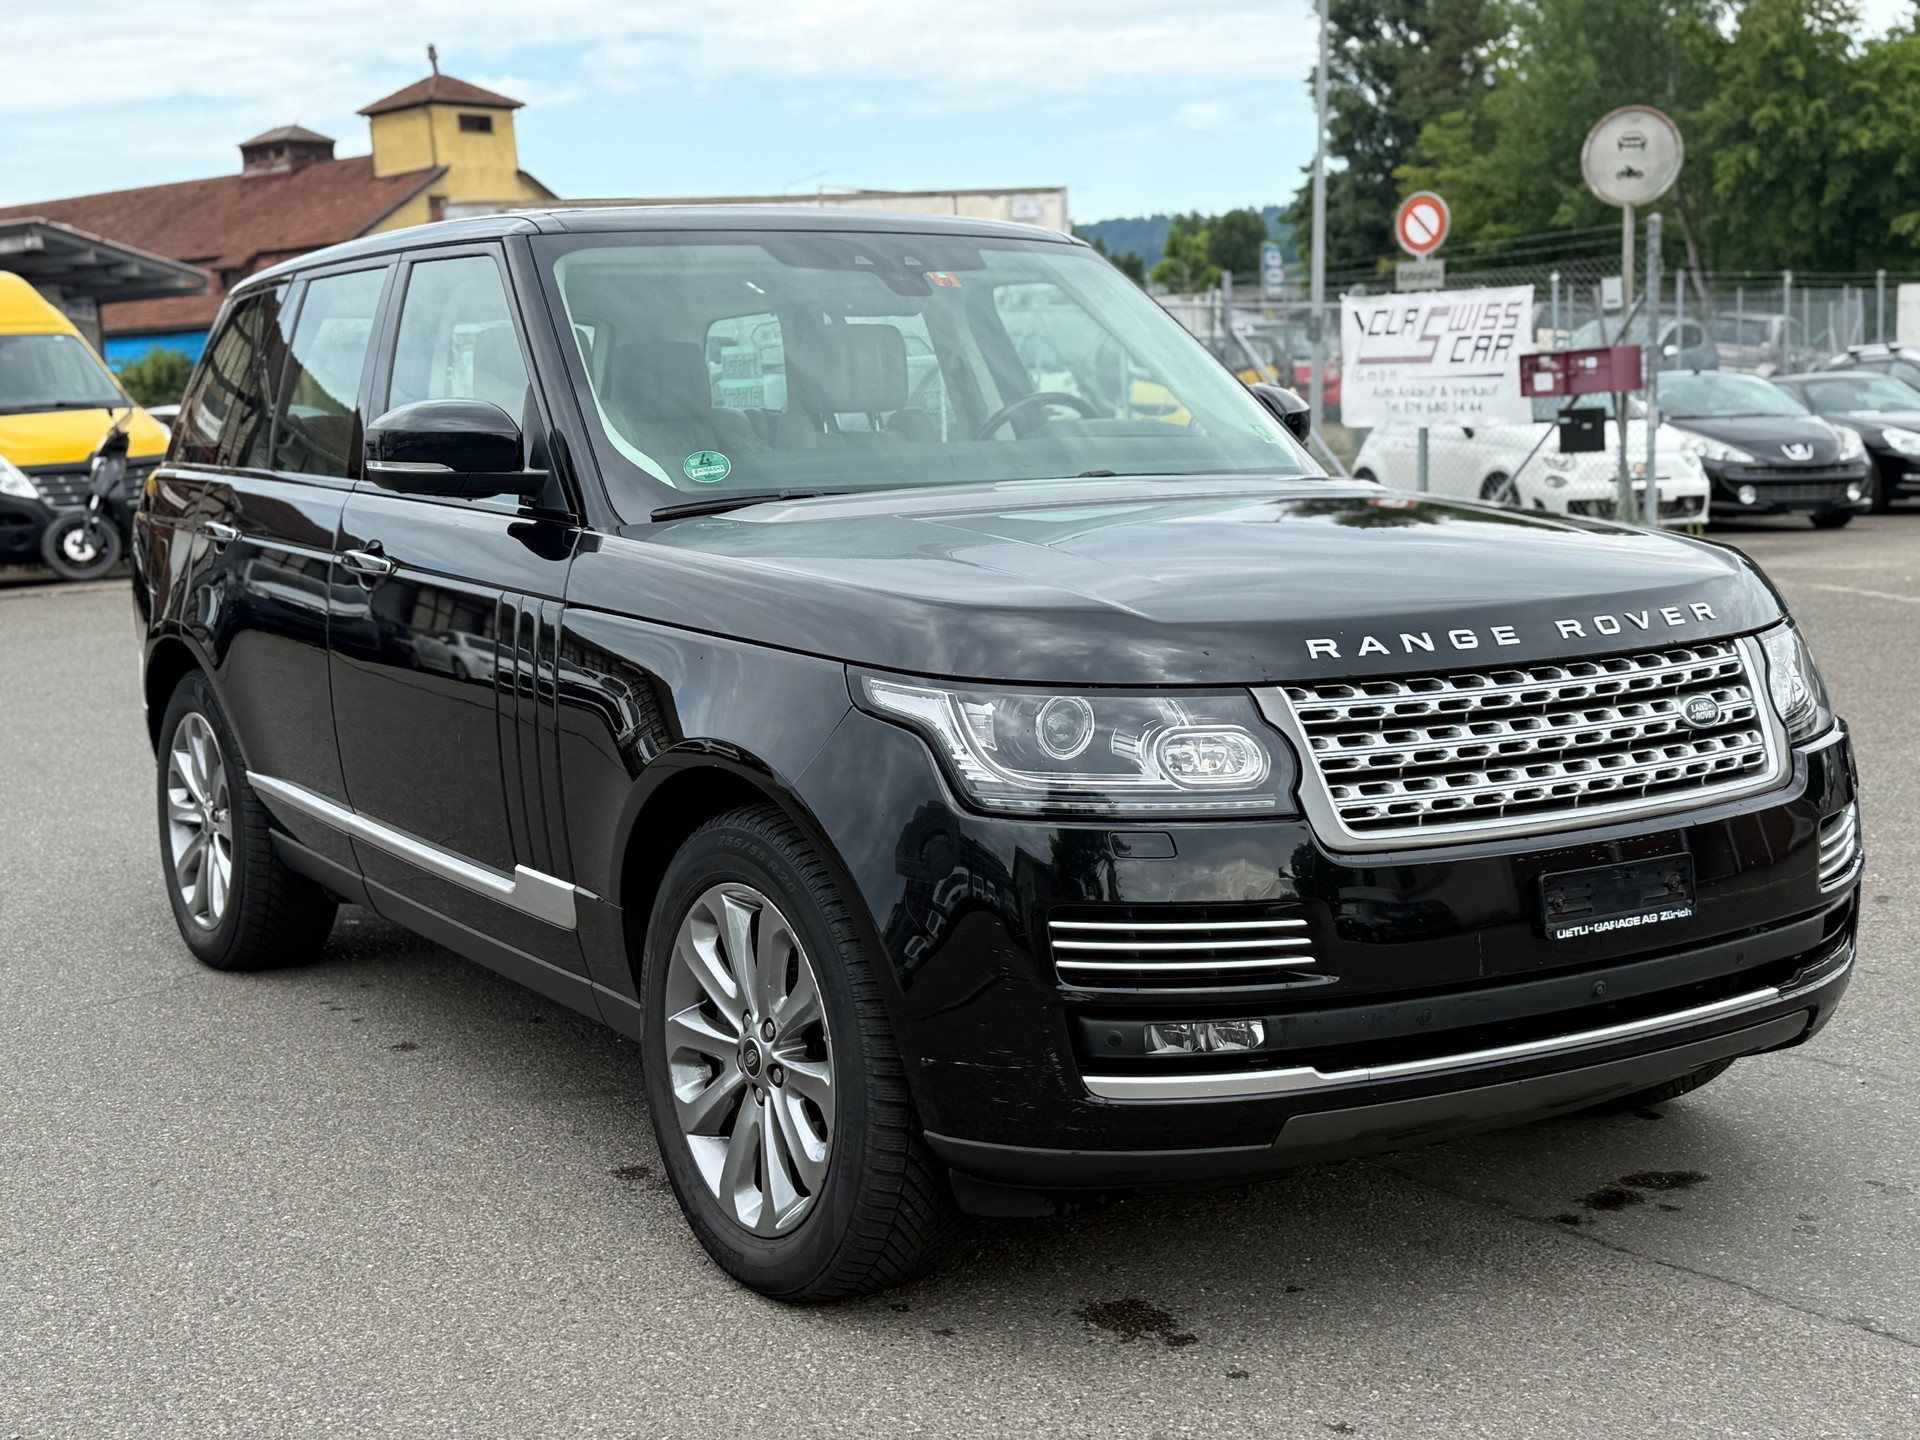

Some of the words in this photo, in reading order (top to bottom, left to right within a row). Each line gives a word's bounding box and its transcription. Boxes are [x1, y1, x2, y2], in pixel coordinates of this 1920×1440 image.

[1449, 333, 1515, 364] CAR
[1306, 625, 1521, 660] RANGE
[1554, 602, 1717, 639] ROVER
[1641, 913, 1658, 925] AG
[1660, 908, 1692, 922] Zürich
